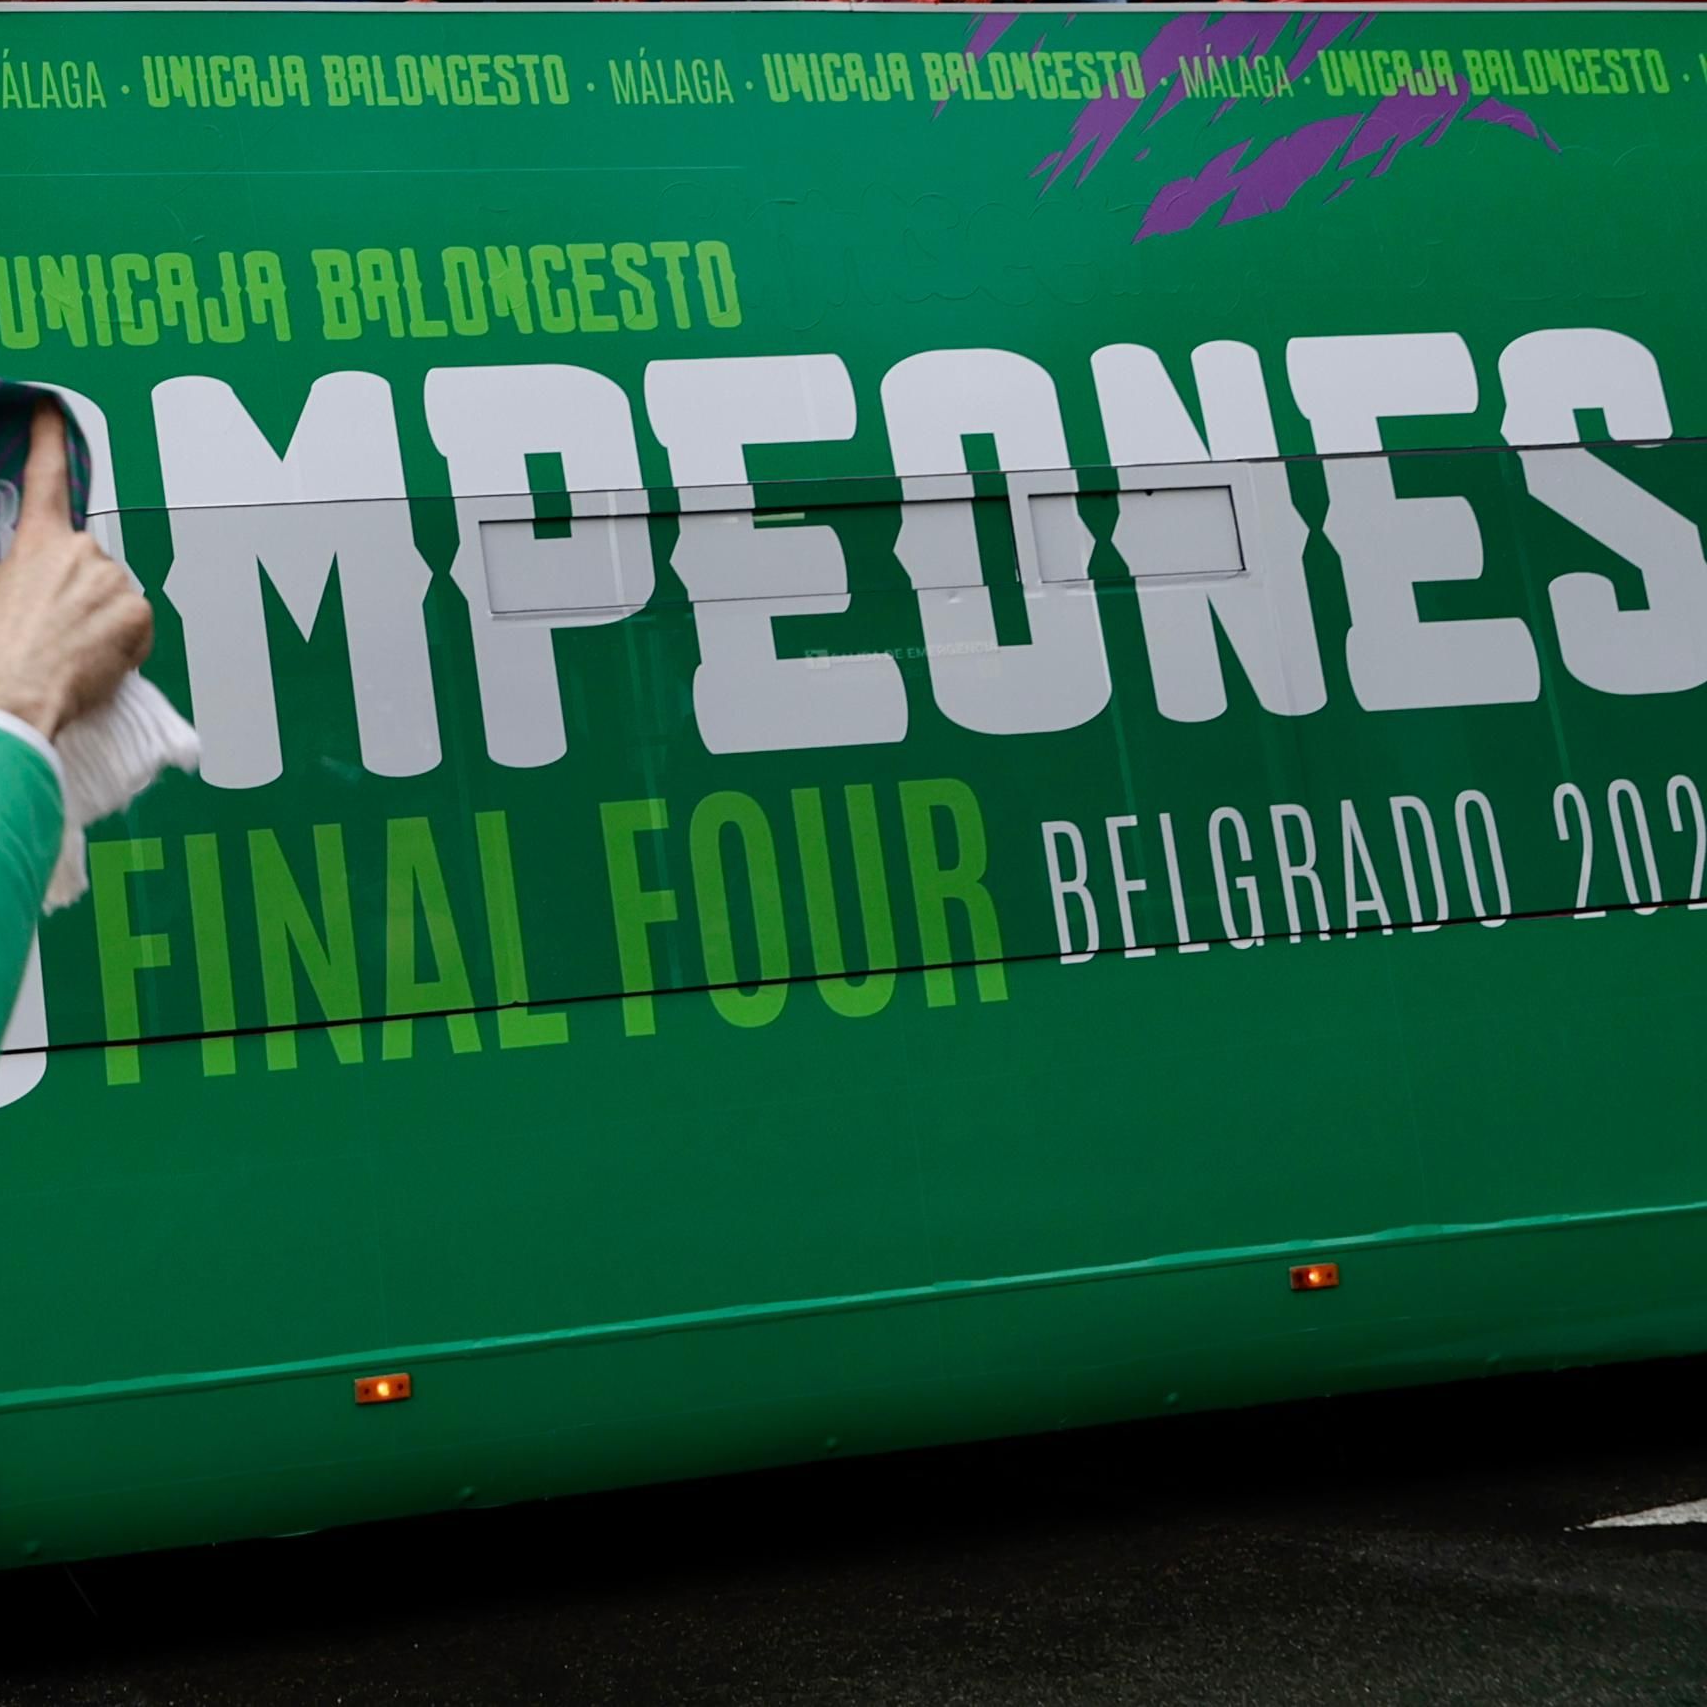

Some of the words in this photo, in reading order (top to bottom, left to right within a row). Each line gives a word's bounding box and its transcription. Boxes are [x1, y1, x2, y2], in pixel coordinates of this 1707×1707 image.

[142, 55, 311, 108] UNICAJA
[321, 54, 570, 107] BALONCESTO
[608, 47, 735, 105] MÁLAGA
[762, 52, 912, 103] UNICAJA
[920, 50, 1146, 101] BALONCESTO
[1178, 43, 1295, 99] MÁLAGA
[1316, 49, 1460, 98] UNICAJA
[1465, 48, 1670, 95] BALONCESTO
[313, 240, 742, 341] BALONCESTO
[88, 811, 570, 1086] FINAL
[599, 778, 1009, 1037] FOUR
[1042, 789, 1512, 965] BELGRADO
